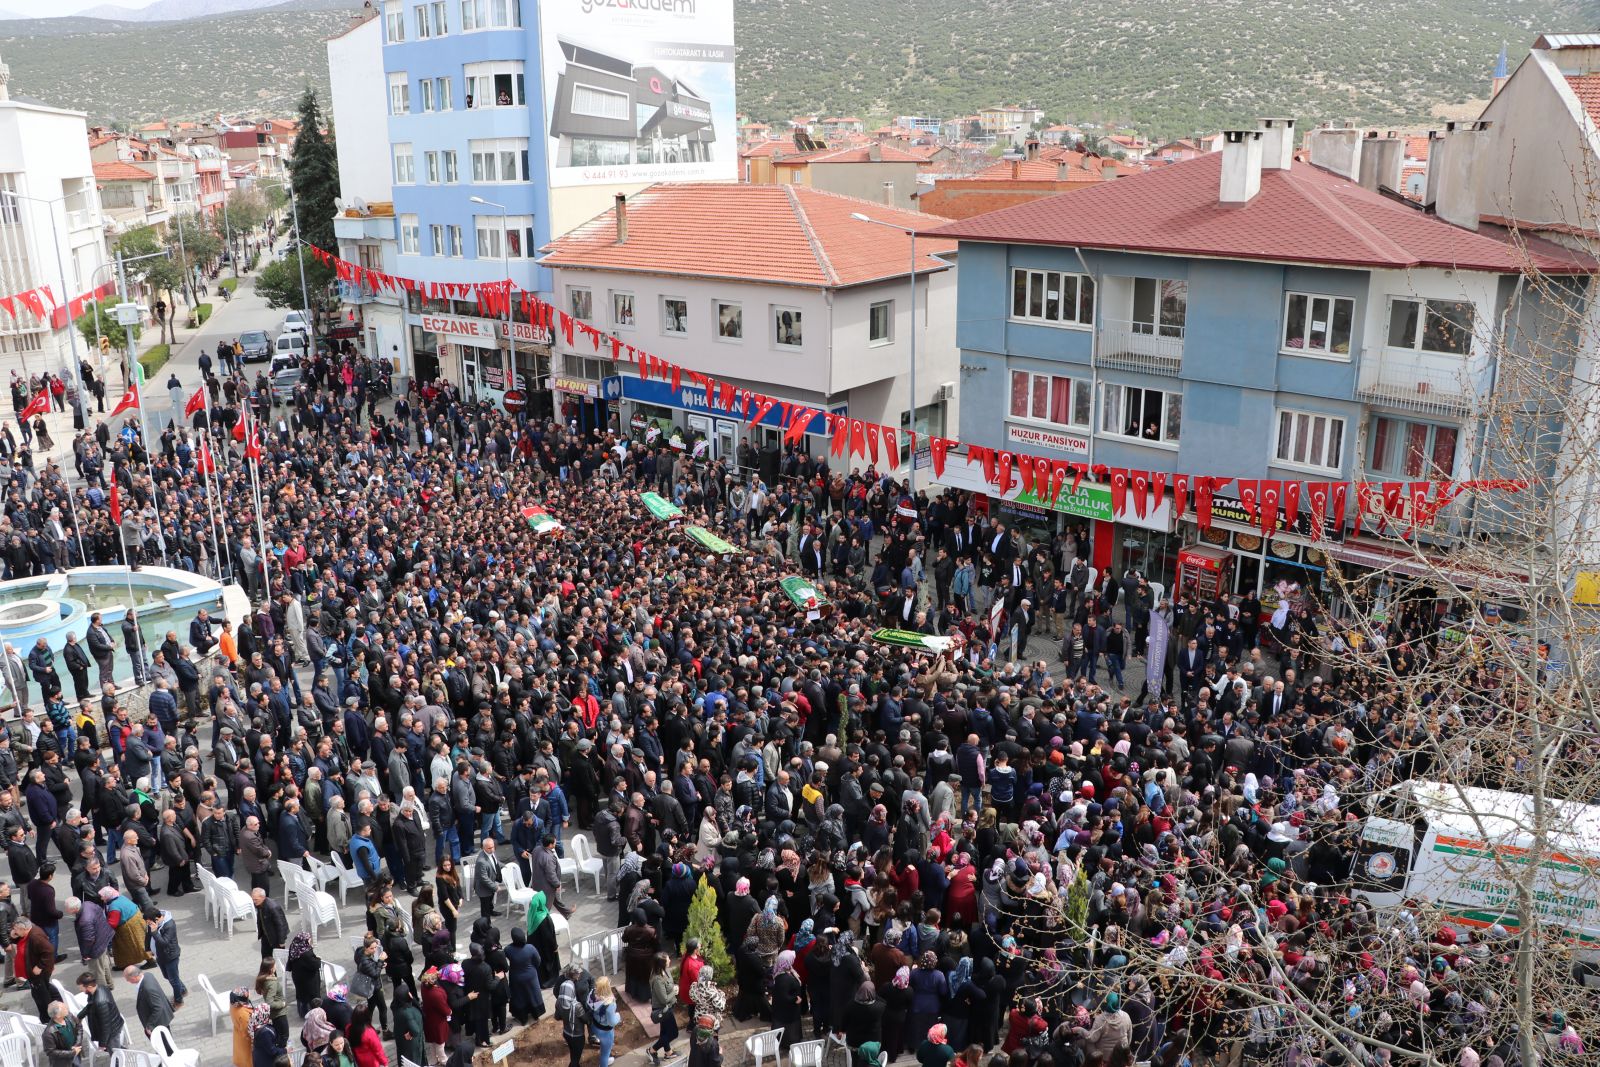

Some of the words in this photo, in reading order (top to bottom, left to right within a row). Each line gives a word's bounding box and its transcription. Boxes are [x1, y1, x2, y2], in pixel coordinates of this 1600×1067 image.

[423, 318, 479, 336] ECZANE
[1011, 429, 1041, 441] HUZUR
[1042, 433, 1086, 449] PANSİYON
[1026, 489, 1110, 512] AKÇULUK
[1211, 508, 1282, 530] KURUYEŞ
